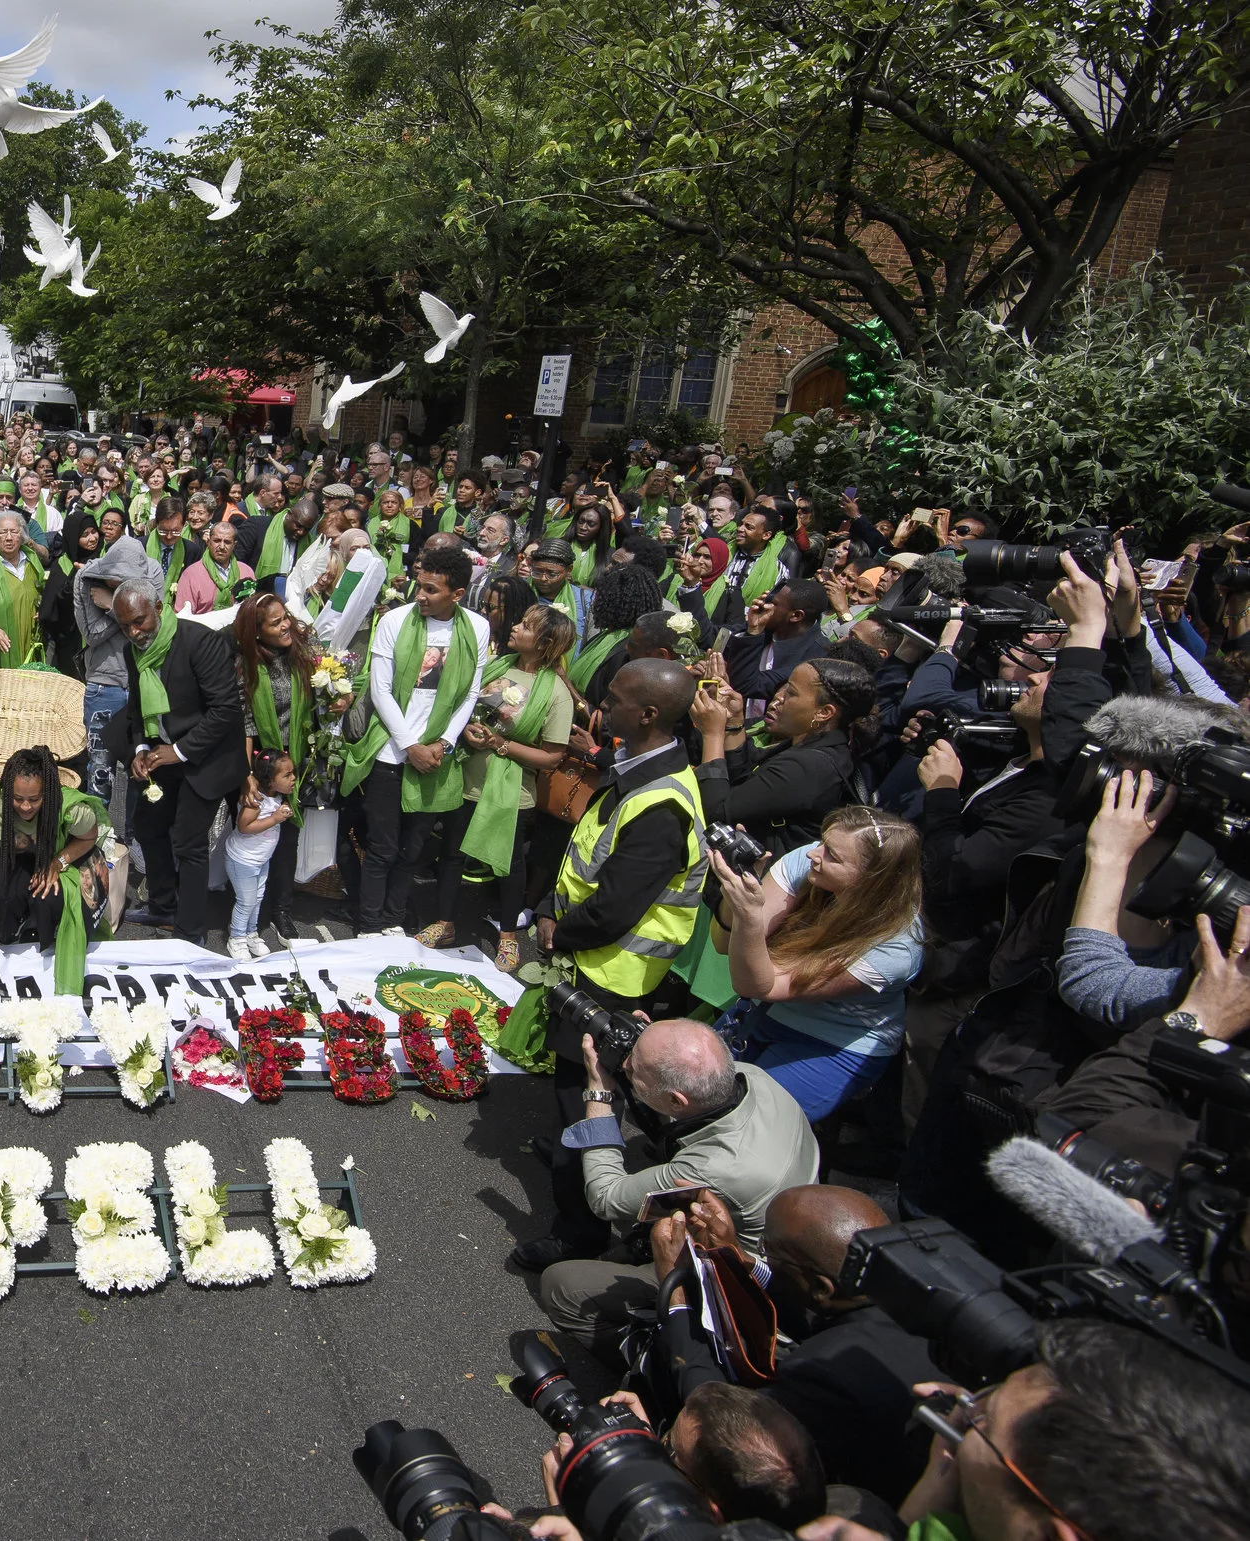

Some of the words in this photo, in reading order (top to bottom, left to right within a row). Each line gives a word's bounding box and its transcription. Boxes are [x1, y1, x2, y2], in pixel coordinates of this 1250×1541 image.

[543, 370, 550, 384] P
[913, 610, 950, 620] RØDE
[238, 1006, 488, 1102] FBU
